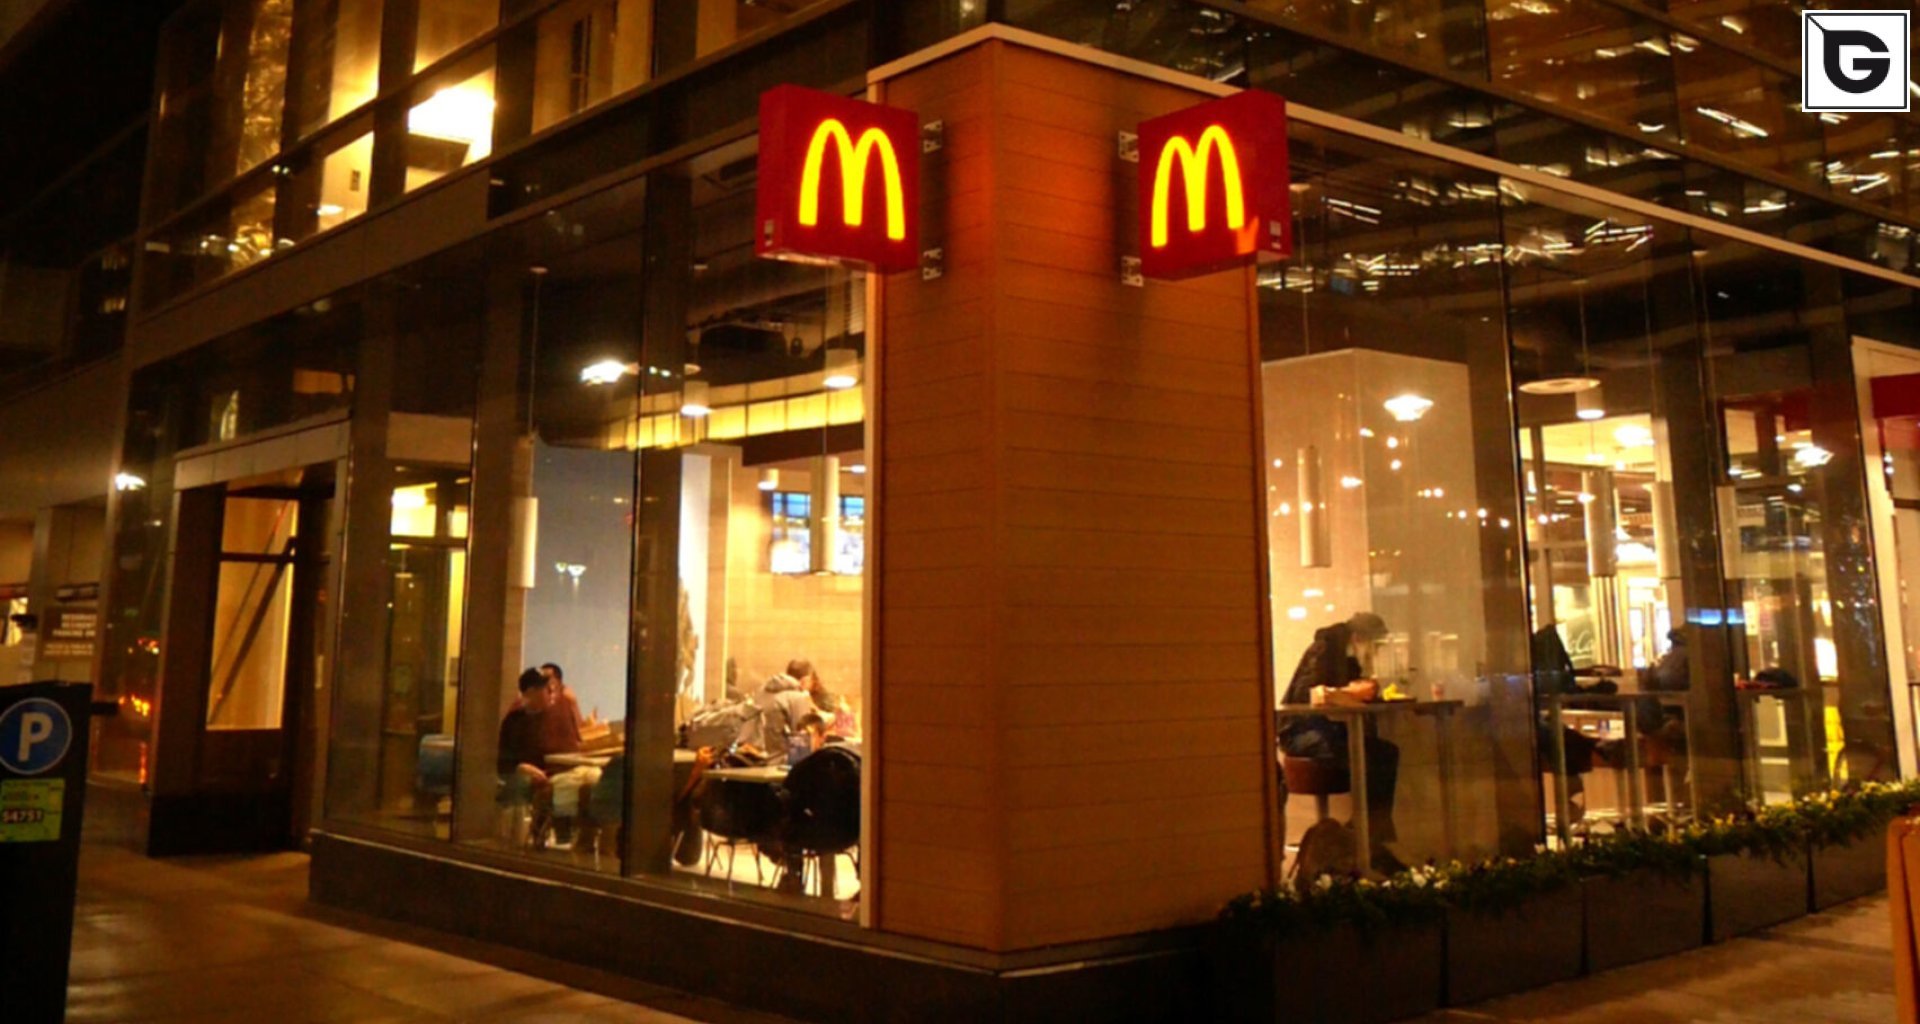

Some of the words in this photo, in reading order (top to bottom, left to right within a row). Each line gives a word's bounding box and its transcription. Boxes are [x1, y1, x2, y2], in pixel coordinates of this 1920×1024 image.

[799, 118, 904, 240] M
[1152, 125, 1244, 247] M
[18, 711, 54, 762] P
